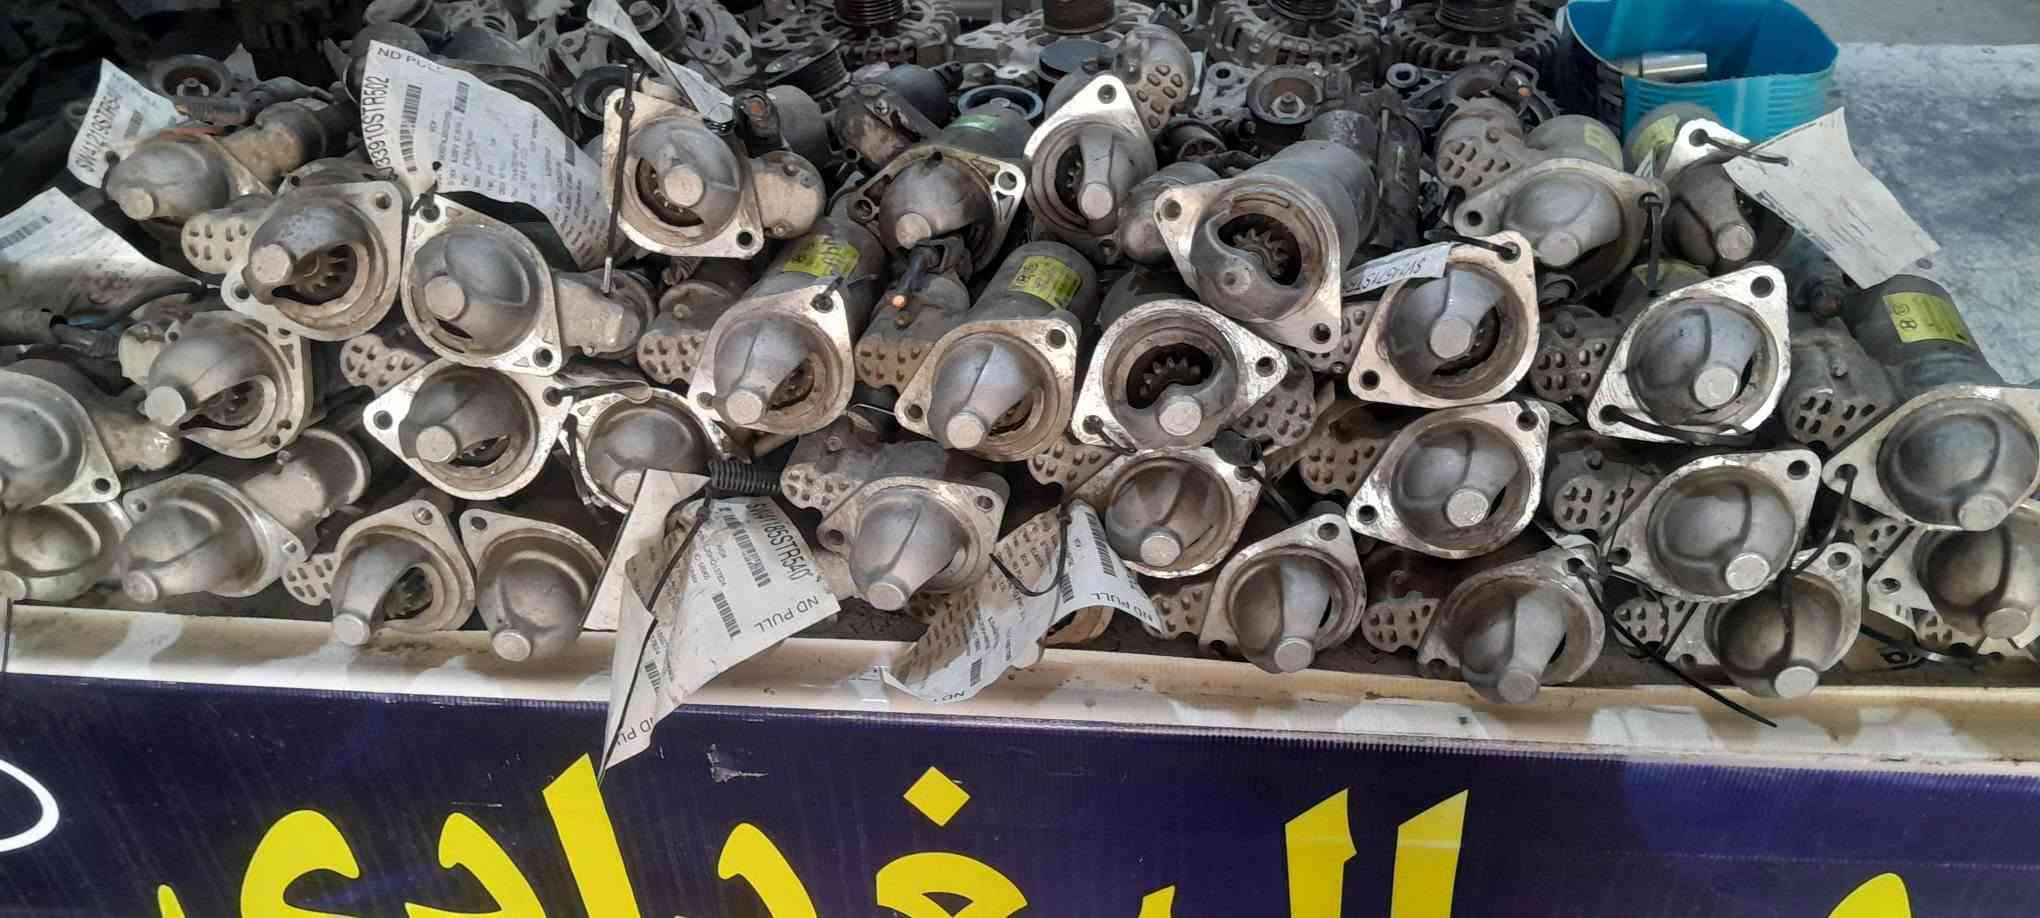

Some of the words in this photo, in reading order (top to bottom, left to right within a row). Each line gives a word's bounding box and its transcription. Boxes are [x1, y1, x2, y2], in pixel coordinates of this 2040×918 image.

[377, 47, 401, 60] ND
[796, 595, 819, 613] ND
[753, 608, 795, 632] PULL
